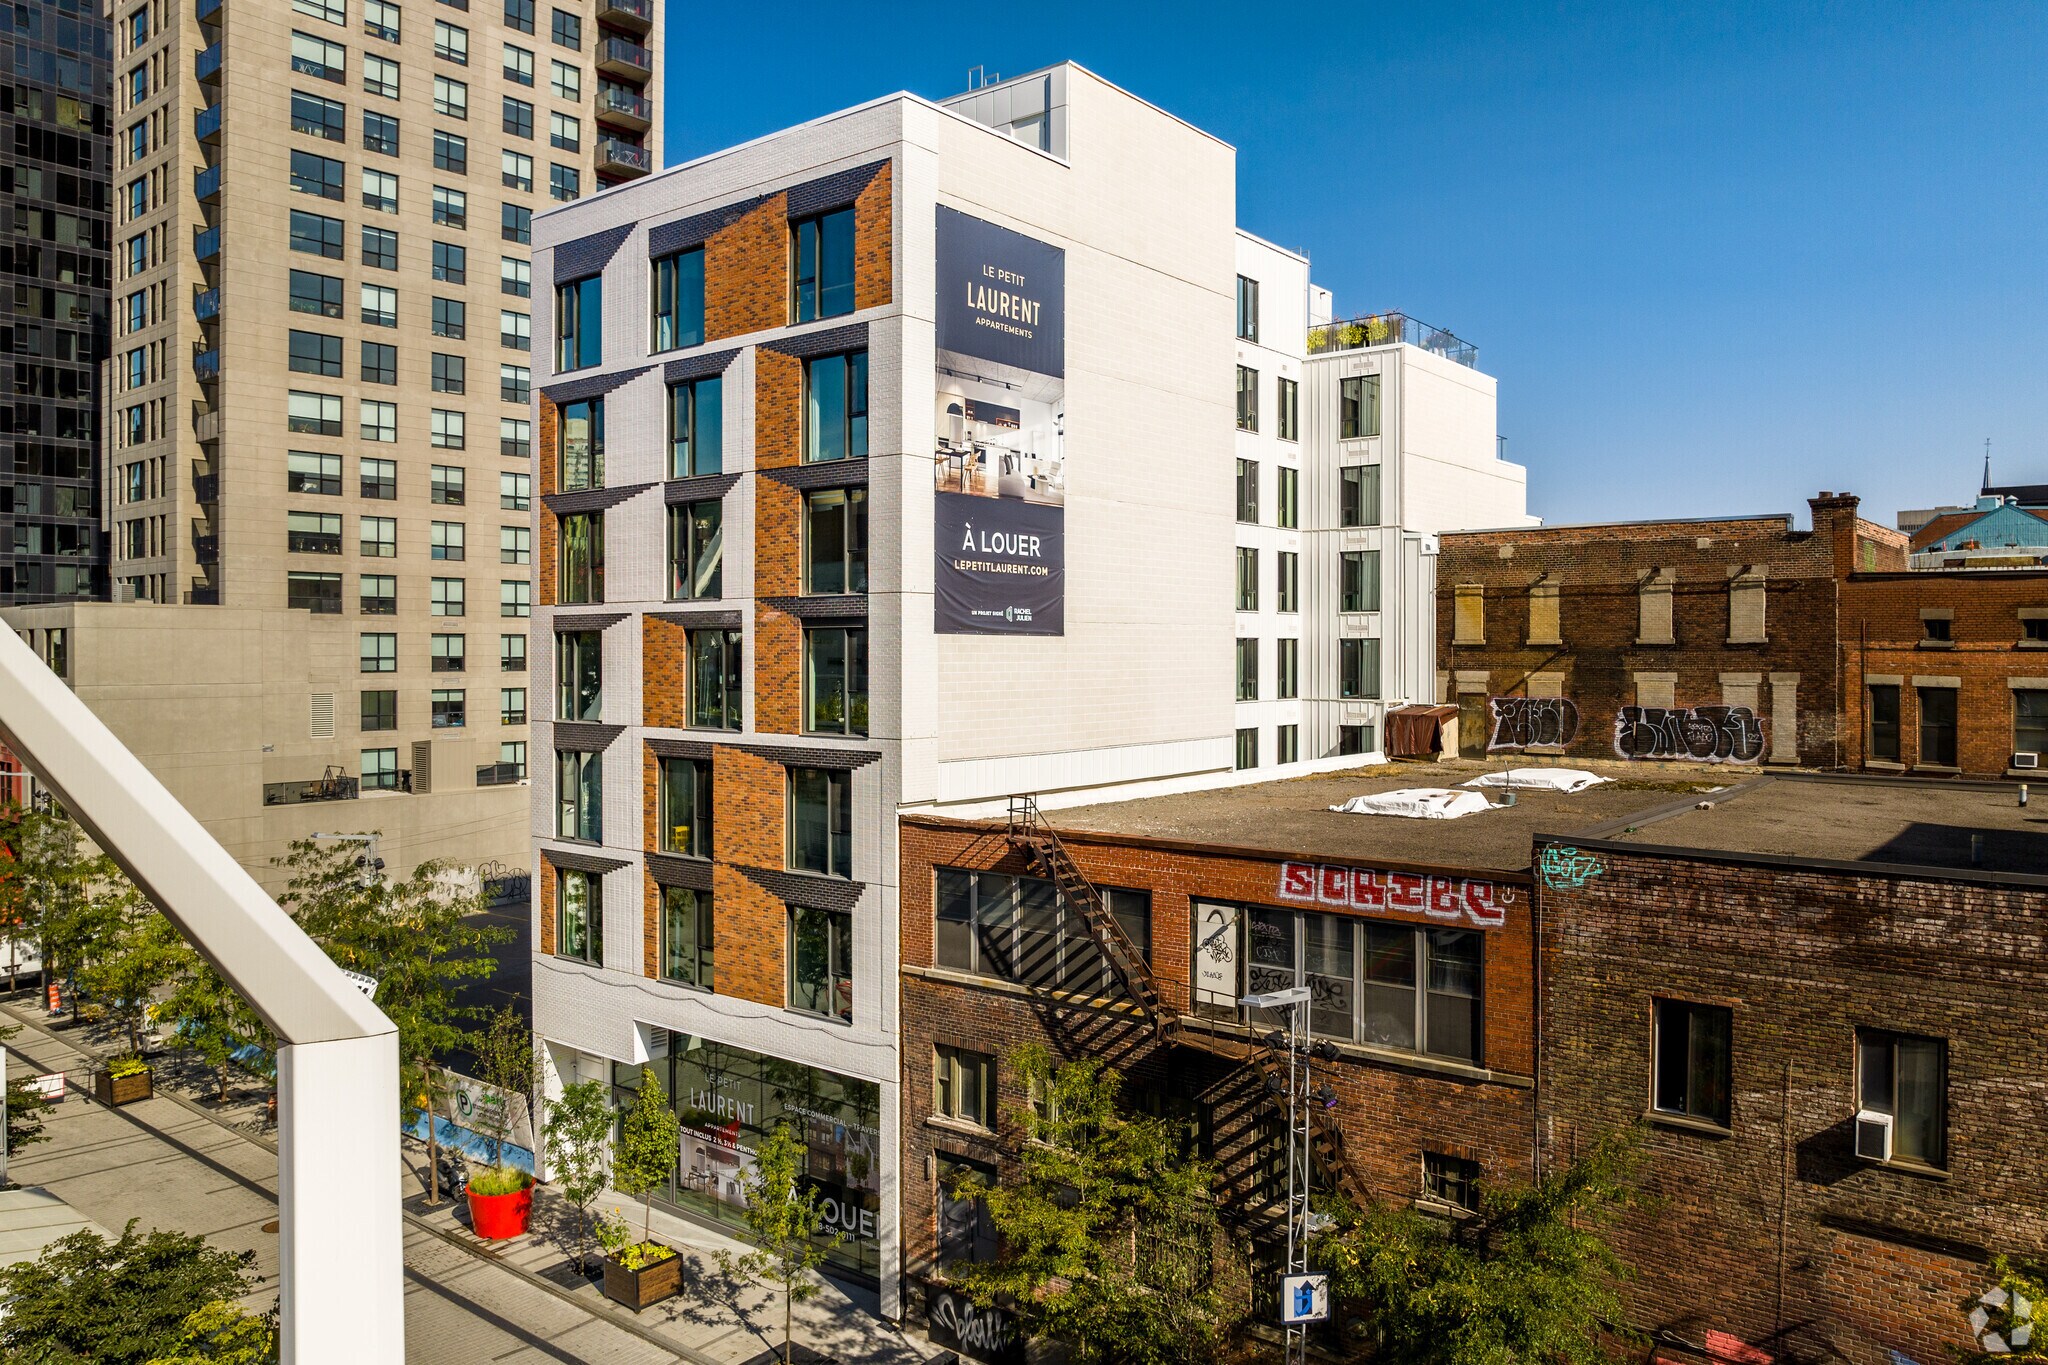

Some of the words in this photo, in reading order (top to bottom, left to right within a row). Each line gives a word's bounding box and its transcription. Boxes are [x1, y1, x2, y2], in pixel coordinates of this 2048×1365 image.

[983, 264, 995, 278] LE
[998, 269, 1025, 287] PETIT
[967, 281, 1041, 326] LAURENT
[975, 316, 1033, 339] APPARTEMENTS
[962, 522, 976, 551] À
[981, 530, 1041, 557] LOUER
[954, 559, 1049, 576] LEPETITLAURENT.COM
[704, 1072, 715, 1084] LE
[717, 1076, 741, 1091] PETIT
[460, 1093, 469, 1110] P
[690, 1087, 754, 1125] LAURENT
[784, 1103, 806, 1115] ESPACE
[806, 1110, 847, 1127] COMMERCIAL
[680, 1126, 693, 1134] TOUT
[693, 1130, 712, 1141] INCLUS
[704, 1122, 741, 1138] APPARTEMENTS
